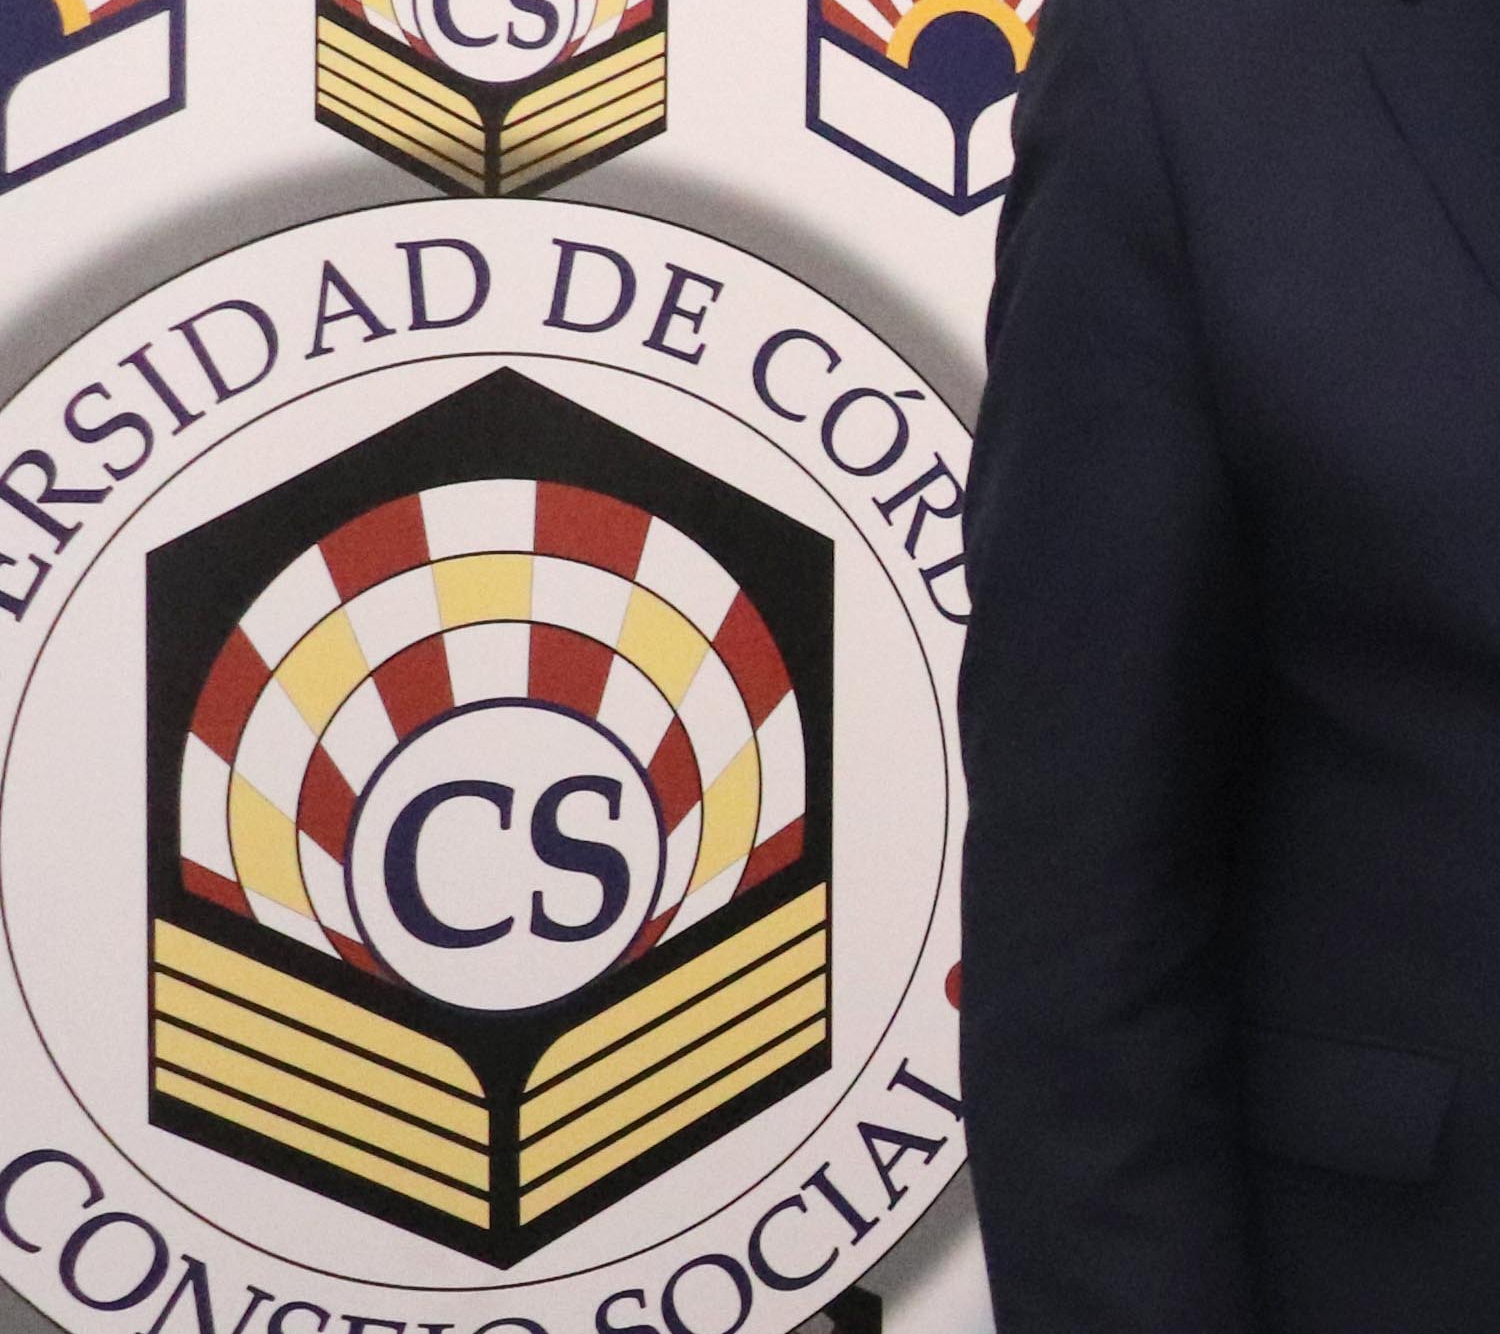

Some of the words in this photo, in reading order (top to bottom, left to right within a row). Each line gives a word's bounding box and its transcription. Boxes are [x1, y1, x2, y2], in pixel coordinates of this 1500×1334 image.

[0, 238, 493, 622] ERSIDAD
[543, 237, 724, 366] DE
[753, 327, 972, 627] CÓRD
[382, 773, 632, 951] CS
